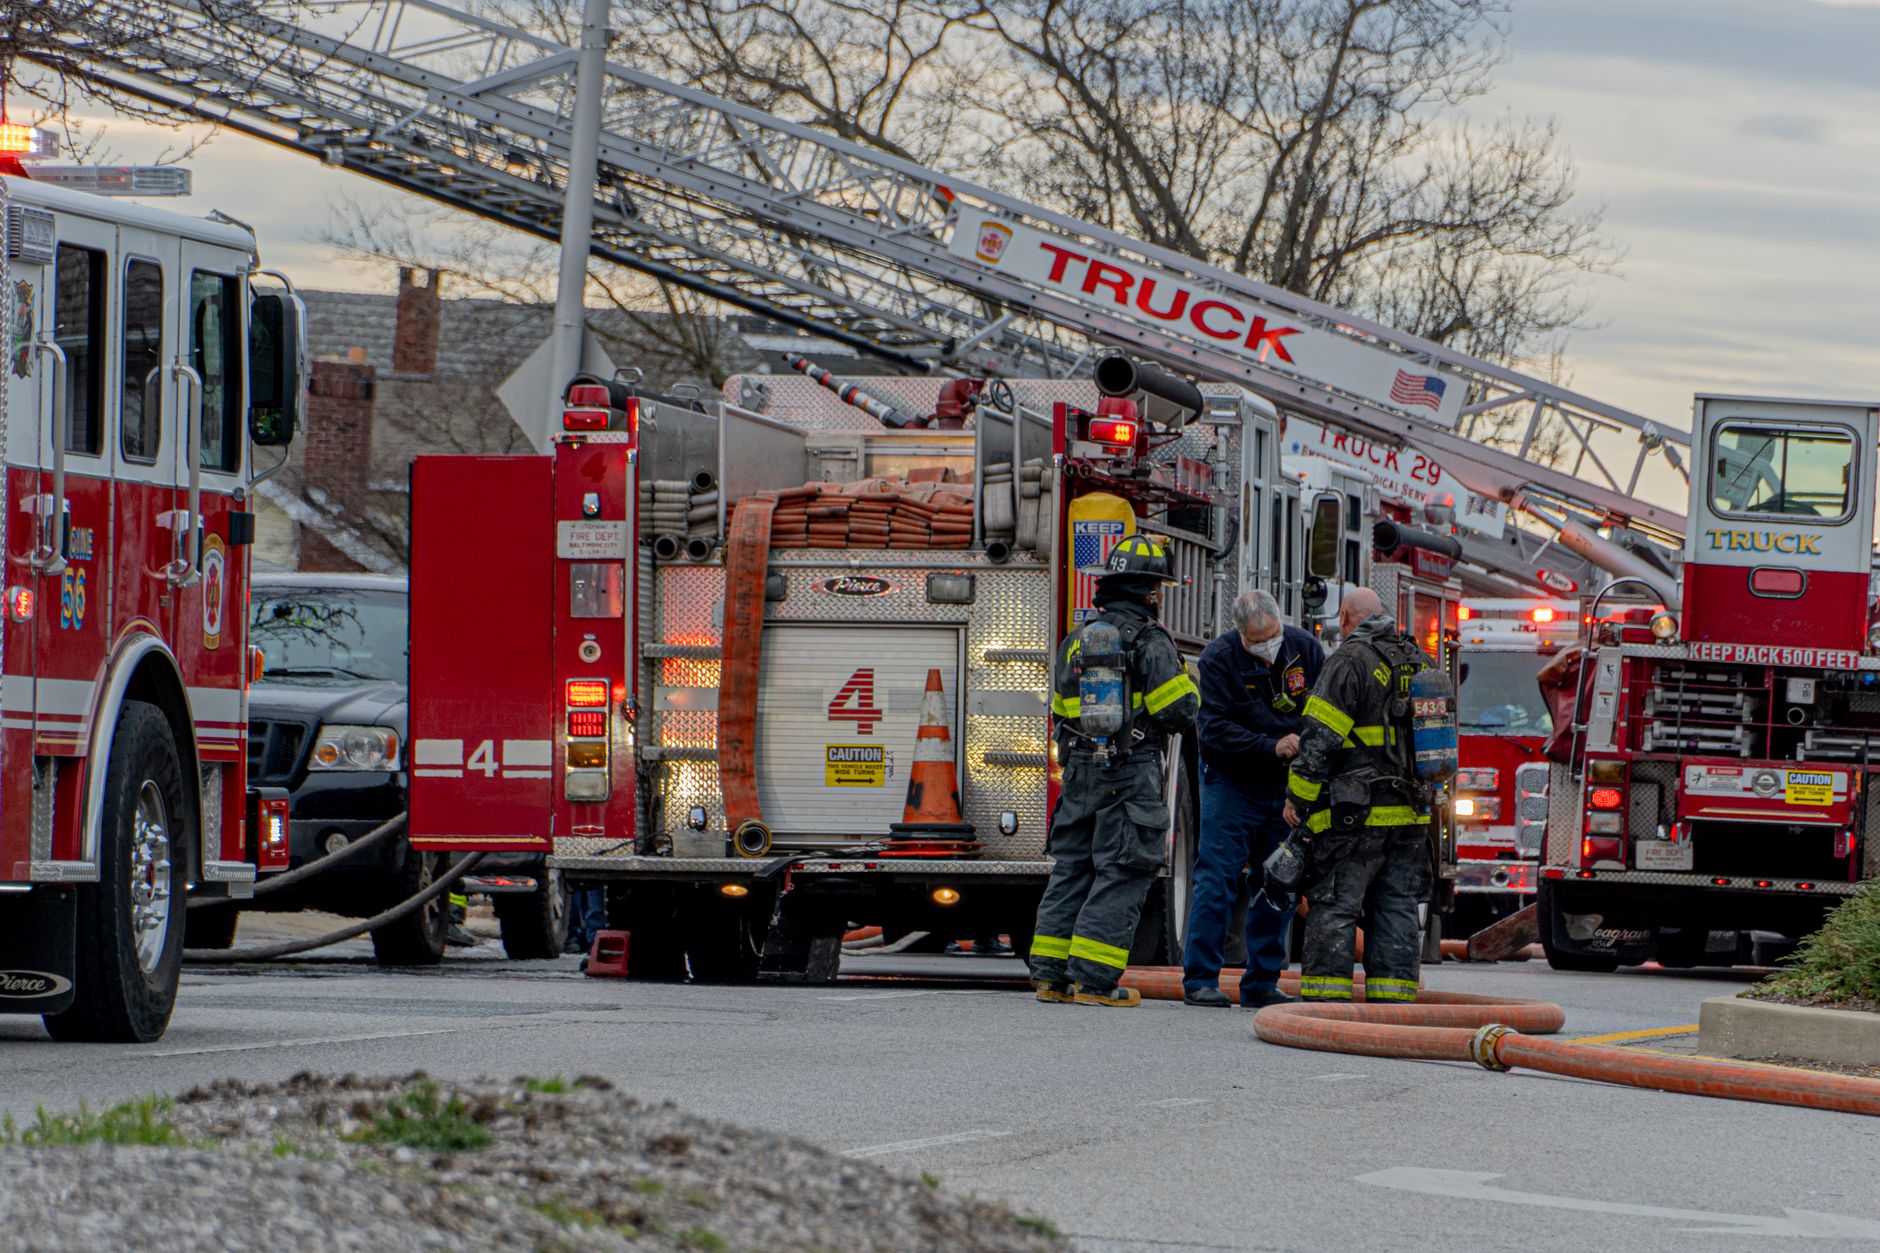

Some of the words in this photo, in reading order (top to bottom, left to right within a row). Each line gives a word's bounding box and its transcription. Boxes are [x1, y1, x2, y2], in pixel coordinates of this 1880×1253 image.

[1040, 242, 1304, 366] TRUCK
[1319, 426, 1400, 474] TRUCK
[1410, 455, 1442, 486] 29
[570, 532, 592, 541] FIRE
[1075, 522, 1123, 534] KEEP
[1705, 528, 1823, 555] TRUCK
[70, 526, 94, 561] GINE
[1110, 556, 1128, 573] 43
[61, 566, 86, 631] 56
[833, 578, 881, 593] Pierce
[1074, 610, 1097, 622] BA
[1689, 642, 1733, 662] KEEP
[1735, 645, 1779, 665] BACK
[1782, 648, 1813, 666] 500
[1816, 650, 1858, 669] FEET
[828, 668, 883, 735] 4
[467, 738, 500, 778] 4
[828, 748, 882, 761] CAUTION
[1789, 773, 1832, 785] CAUTION
